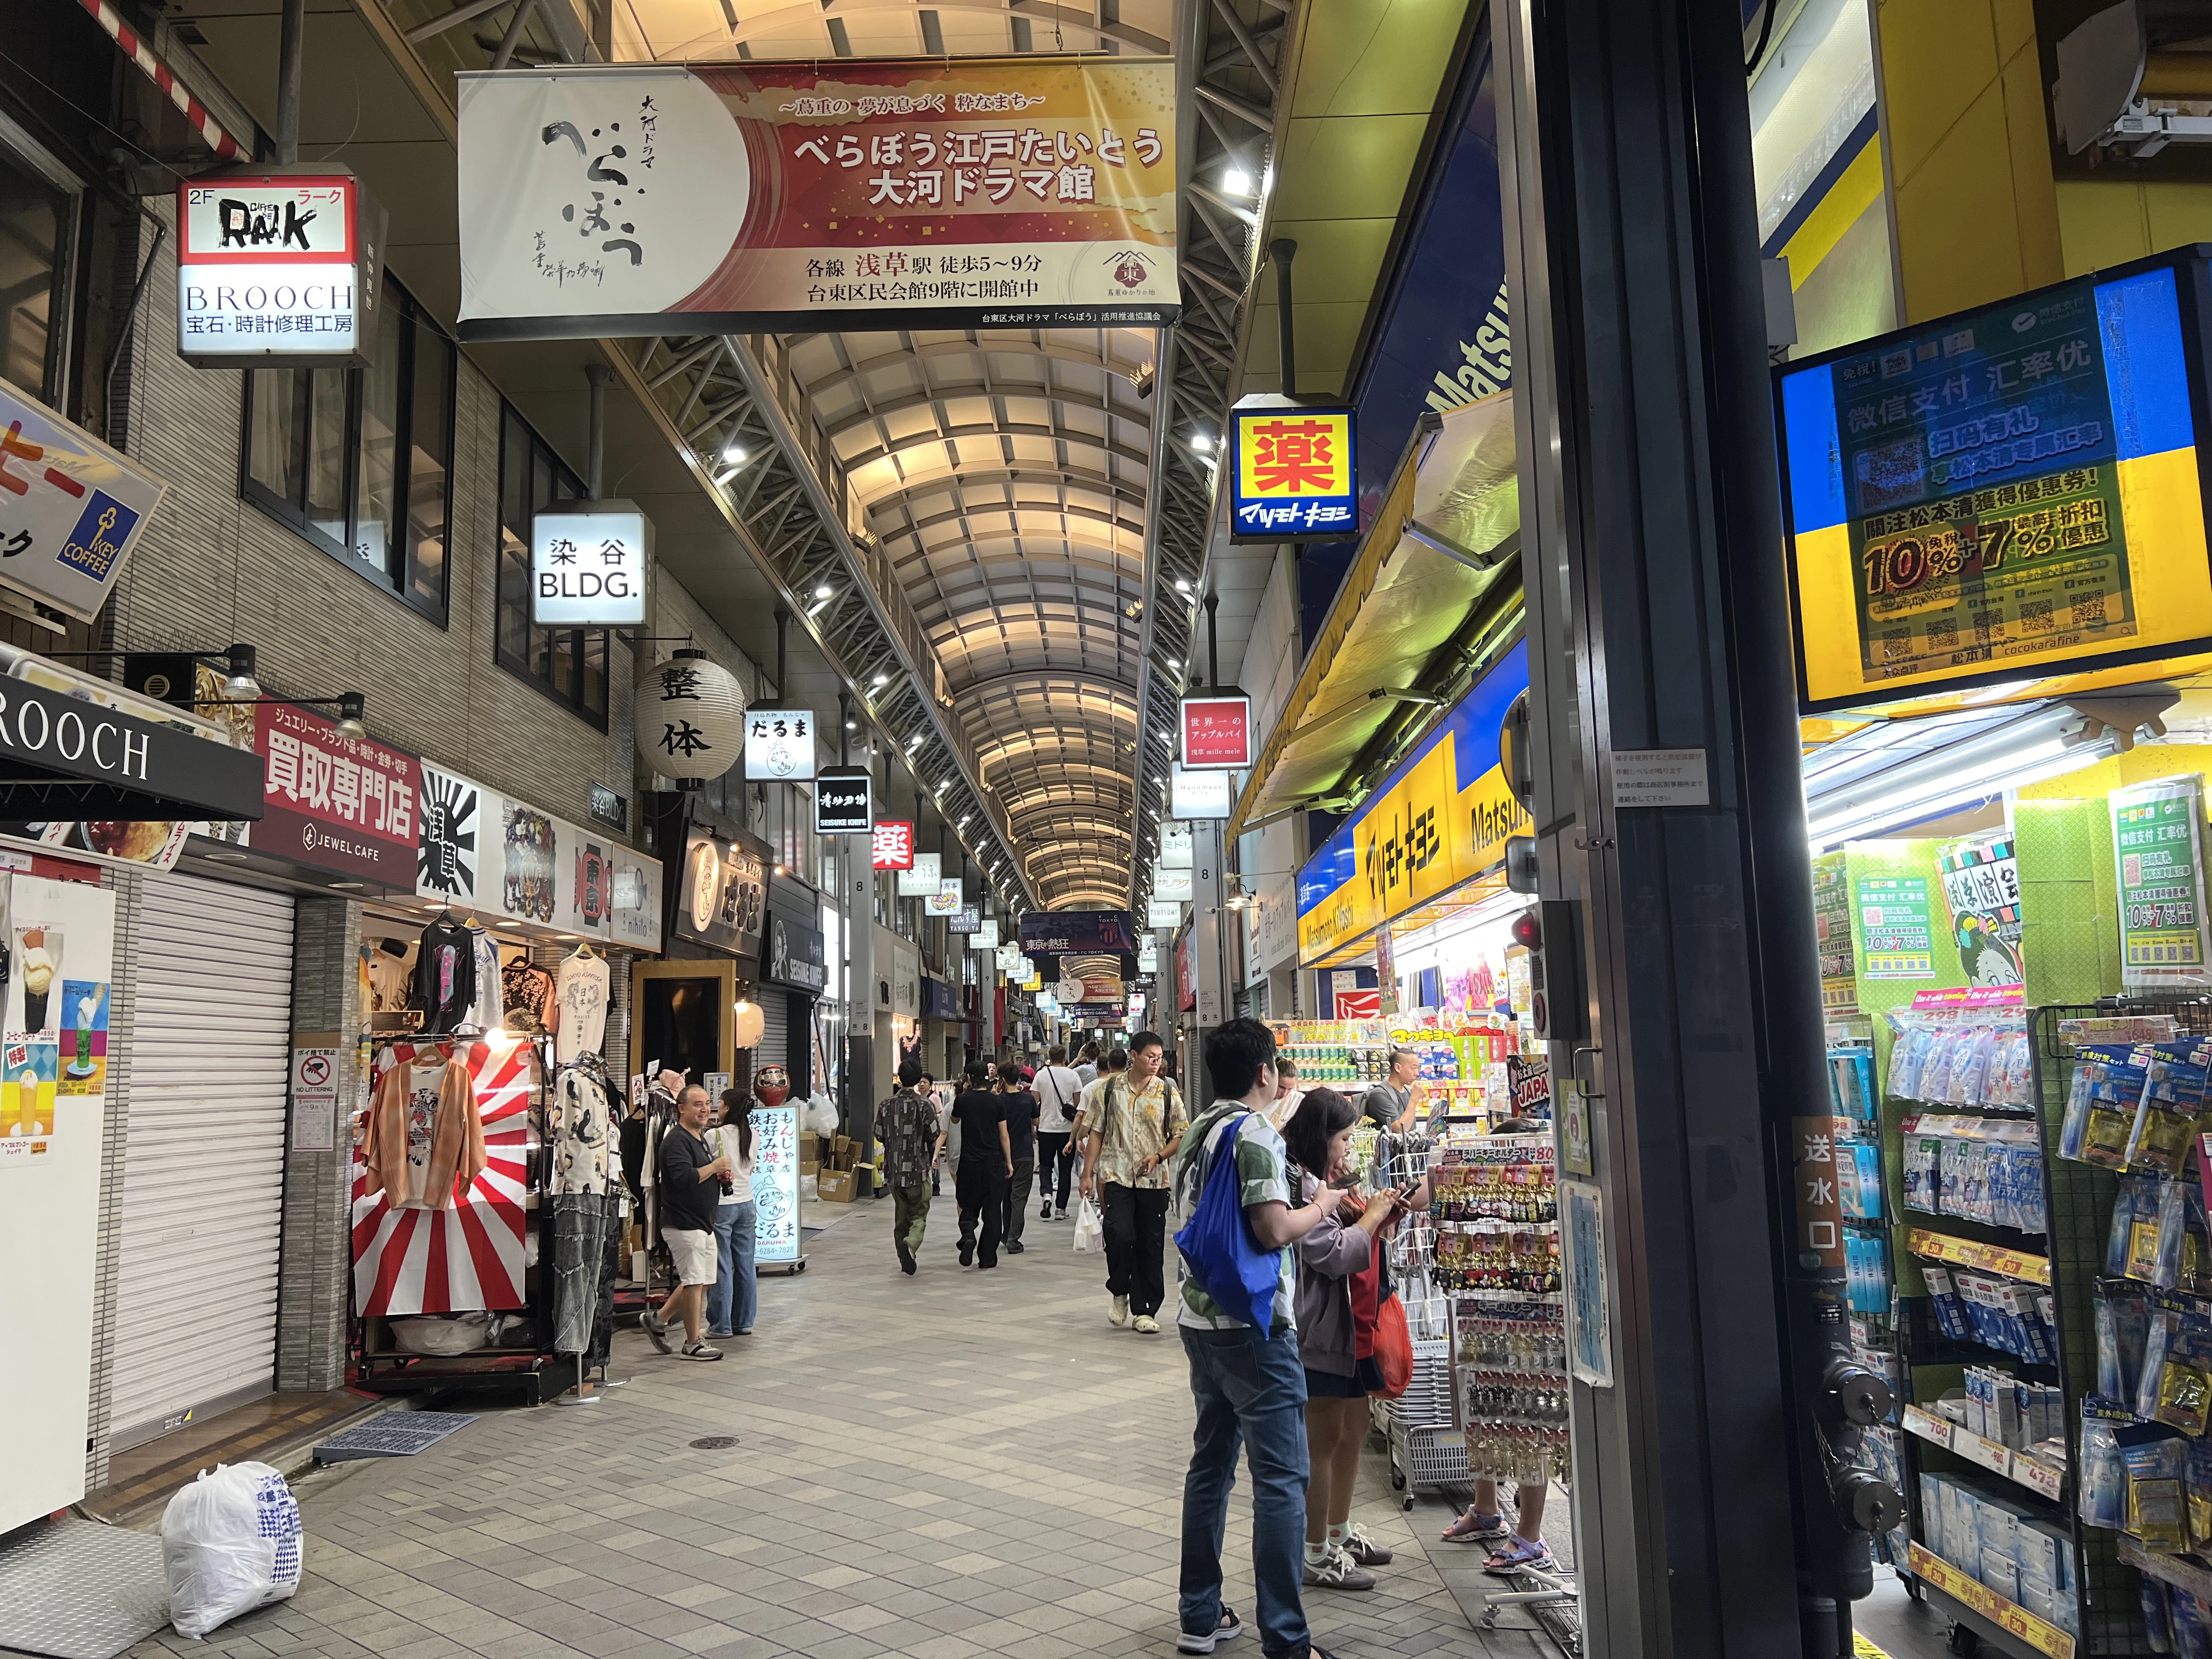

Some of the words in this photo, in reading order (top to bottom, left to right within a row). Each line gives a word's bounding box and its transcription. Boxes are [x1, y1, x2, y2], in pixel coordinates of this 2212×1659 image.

[859, 95, 945, 114] 夢が息づく
[639, 95, 659, 168] 大河ドラマ
[793, 128, 1164, 168] べらぼう江戸たいとう
[869, 165, 1095, 205] 大河ドラマ館
[190, 190, 215, 204] 2F
[298, 190, 341, 204] ラーク
[805, 258, 845, 278] 各線
[856, 251, 932, 278] 浅草駅
[186, 286, 352, 311] BROOCH
[806, 280, 1040, 303] 台東区民会館9階に開館中
[187, 314, 352, 333] 宝石・時計修理工房
[981, 312, 1161, 324] 台東区大河ドラマ「べらぼう」活用推進協議会
[1847, 374, 1970, 433] 微信支付
[1987, 340, 2091, 392] 汇率优
[1928, 407, 2038, 456] 扫码有礼
[1253, 420, 1335, 492] 薬
[1239, 502, 1351, 528] マツモトキヨシ
[2061, 522, 2109, 547] 優惠
[94, 539, 119, 560] KEY
[1864, 538, 1927, 595] 10
[1978, 520, 2017, 569] 7
[2057, 500, 2105, 526] 折扣
[64, 542, 110, 575] COFFEE
[539, 573, 637, 597] BLDG.
[2004, 635, 2080, 656] cocokarafine
[1882, 664, 1918, 679] 大众点评
[658, 667, 712, 758] 整体
[1190, 718, 1242, 727] 世界一の
[752, 719, 806, 738] だるま
[1191, 730, 1242, 740] アップルパイ
[265, 729, 413, 839] 買取専門店
[873, 825, 908, 865] 薬
[2120, 830, 2154, 847] 微信支付
[2157, 824, 2187, 840] 汇率优
[318, 834, 352, 854] JEWEL
[355, 845, 379, 861] CAFE
[1366, 801, 1440, 913] マツモトキヨシ
[1202, 869, 1209, 879] 8
[586, 859, 600, 913] 東京
[856, 882, 862, 891] 8
[1861, 893, 1895, 902] 微信支付
[1899, 893, 1925, 901] 汇率优
[628, 918, 647, 937] nihilo
[2127, 905, 2141, 929] 10
[2154, 905, 2165, 928] 7
[1026, 938, 1069, 951] 東京が熱狂
[1865, 936, 1883, 950] 10
[1895, 937, 1905, 950] 7
[790, 958, 809, 983] SEISUKE
[809, 964, 822, 988] KNIFE
[579, 988, 586, 1005] 日本
[1916, 995, 1925, 1003] Use
[1923, 1010, 1959, 1021] 298
[1390, 1029, 1455, 1042] マツキヨの
[2132, 1029, 2154, 1042] 648
[8, 1045, 26, 1066] 特製
[1519, 1074, 1549, 1107] JAPA
[763, 1112, 780, 1164] お好み焼
[780, 1111, 795, 1160] もんじゃ
[1804, 1134, 1836, 1249] 送水口
[1929, 1244, 1939, 1253] 30
[2005, 1262, 2016, 1271] 30
[1477, 1301, 1532, 1313] キーホルダー
[1930, 1422, 1948, 1438] 700
[1993, 1452, 2003, 1464] 980
[1932, 1570, 1942, 1582] 30
[1961, 1581, 1982, 1602] 516
[2011, 1618, 2022, 1633] 30
[2044, 1632, 2070, 1657] 516
